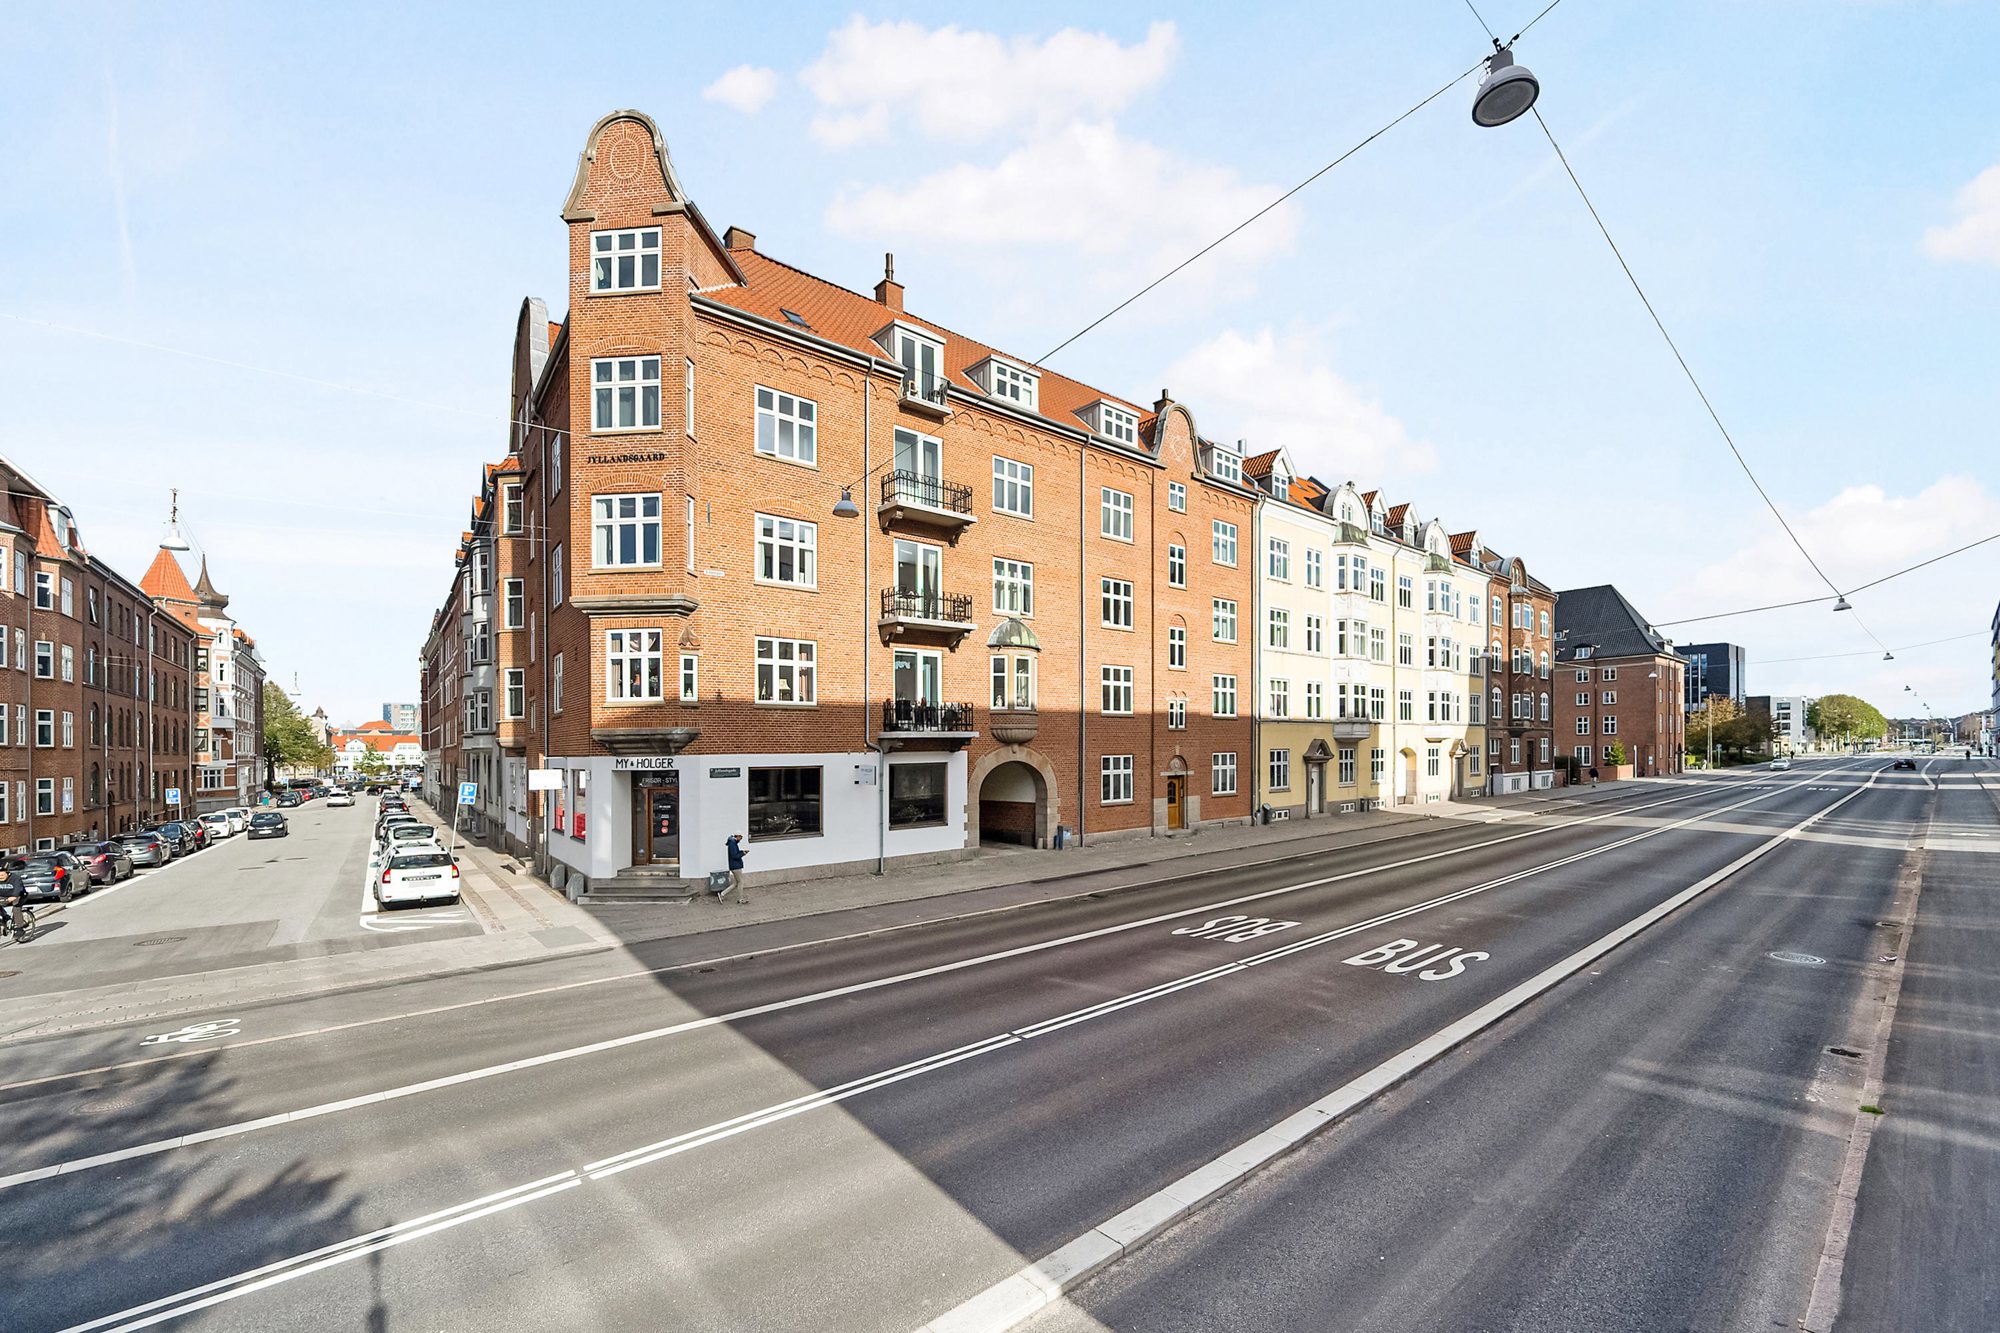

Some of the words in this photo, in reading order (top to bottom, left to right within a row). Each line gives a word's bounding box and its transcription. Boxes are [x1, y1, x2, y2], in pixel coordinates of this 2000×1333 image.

[616, 758, 629, 768] MY
[636, 758, 674, 768] HOLGER
[463, 785, 474, 796] P
[1170, 914, 1302, 943] BUS
[1341, 938, 1491, 981] BUS
